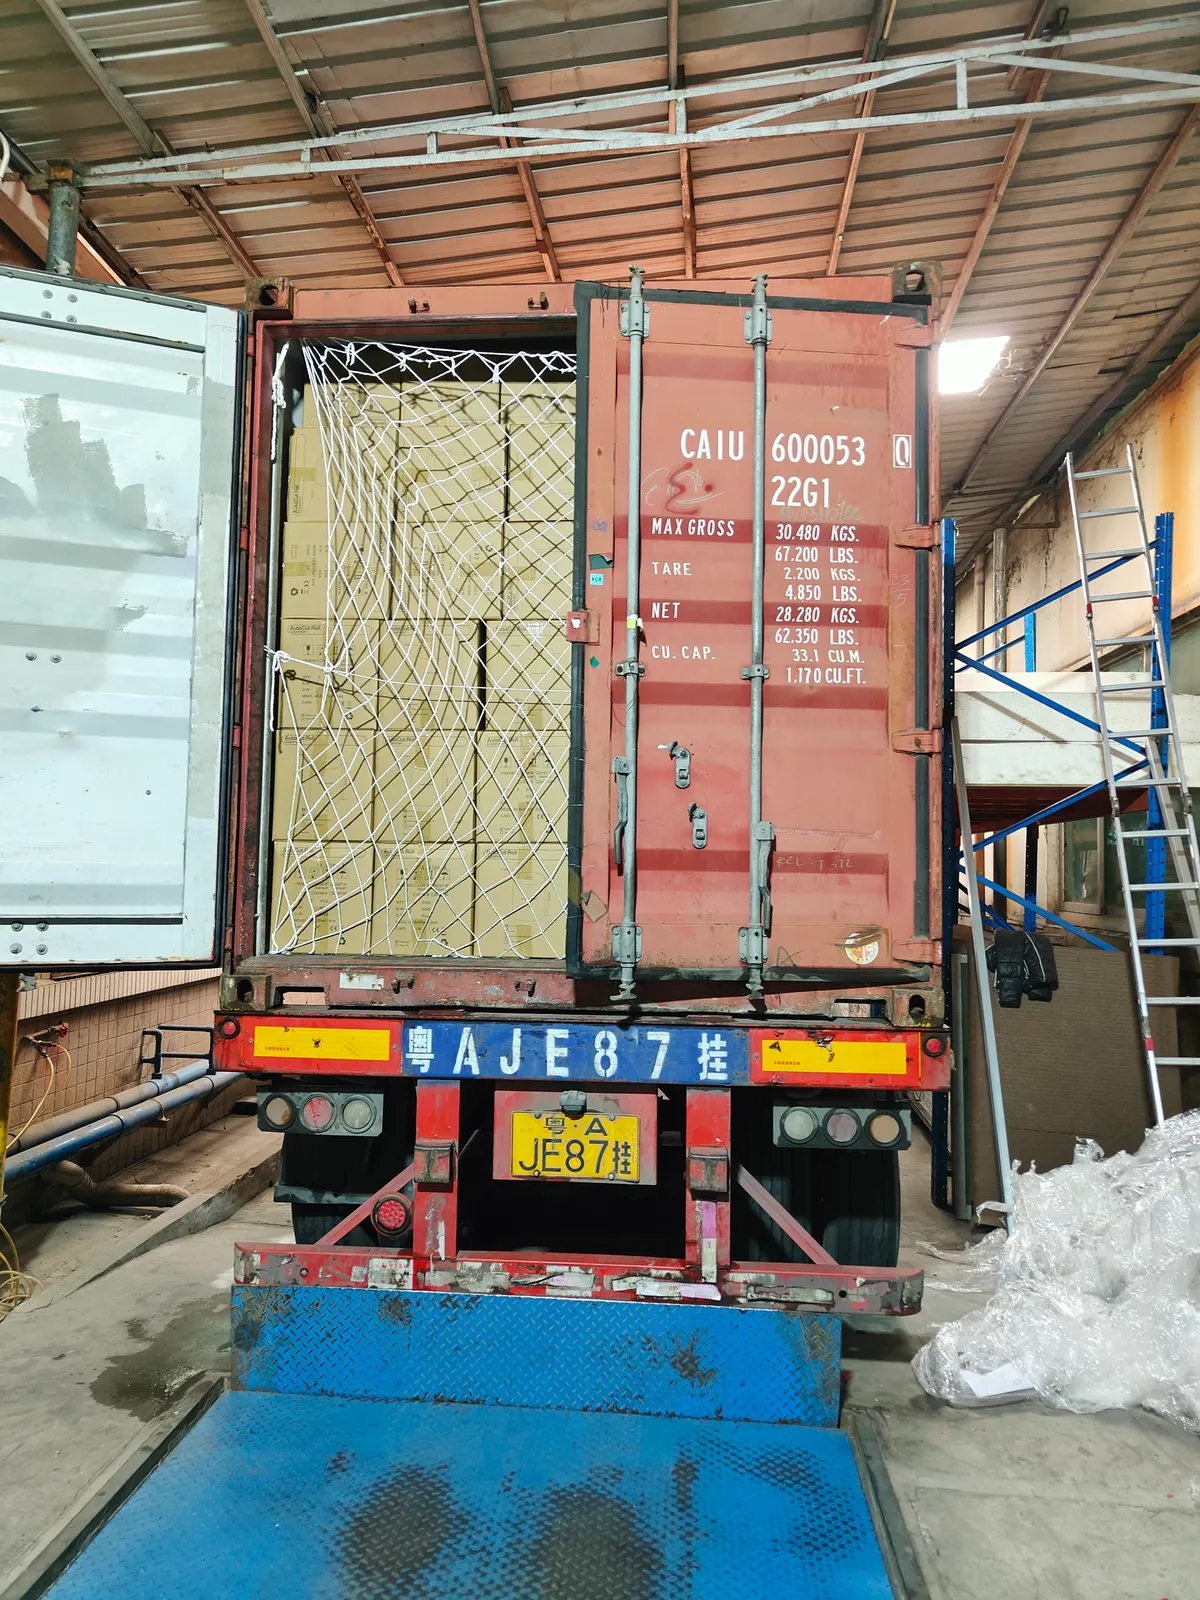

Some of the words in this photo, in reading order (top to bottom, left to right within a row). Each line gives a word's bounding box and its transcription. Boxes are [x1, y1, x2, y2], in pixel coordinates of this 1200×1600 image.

[680, 428, 744, 461] CAIU
[771, 432, 866, 466] 600053
[895, 436, 909, 466] 0
[771, 475, 830, 508] 22G1
[651, 517, 683, 536] MAX
[688, 518, 735, 537] GROSS
[775, 523, 820, 542] 30.480
[830, 525, 860, 542] KGS.
[775, 545, 819, 563] 67.200
[829, 547, 858, 564] LBS.
[651, 561, 692, 576] TARE
[783, 566, 820, 581] 2.200
[830, 567, 861, 582] KGS.
[785, 584, 821, 601] 4.850
[832, 586, 862, 602] LBS.
[651, 602, 681, 619] NET
[775, 606, 820, 623] 28.280
[830, 607, 860, 624] KGS.
[775, 627, 819, 645] 62.350
[830, 629, 859, 645] LBS.
[651, 645, 676, 659] CU.
[681, 645, 716, 660] CAP.
[791, 648, 819, 662] 33.1
[828, 649, 865, 663] CU.M.
[787, 667, 822, 684] 1.170
[825, 668, 867, 684] CU.FT.
[518, 1138, 631, 1175] JE87挂
